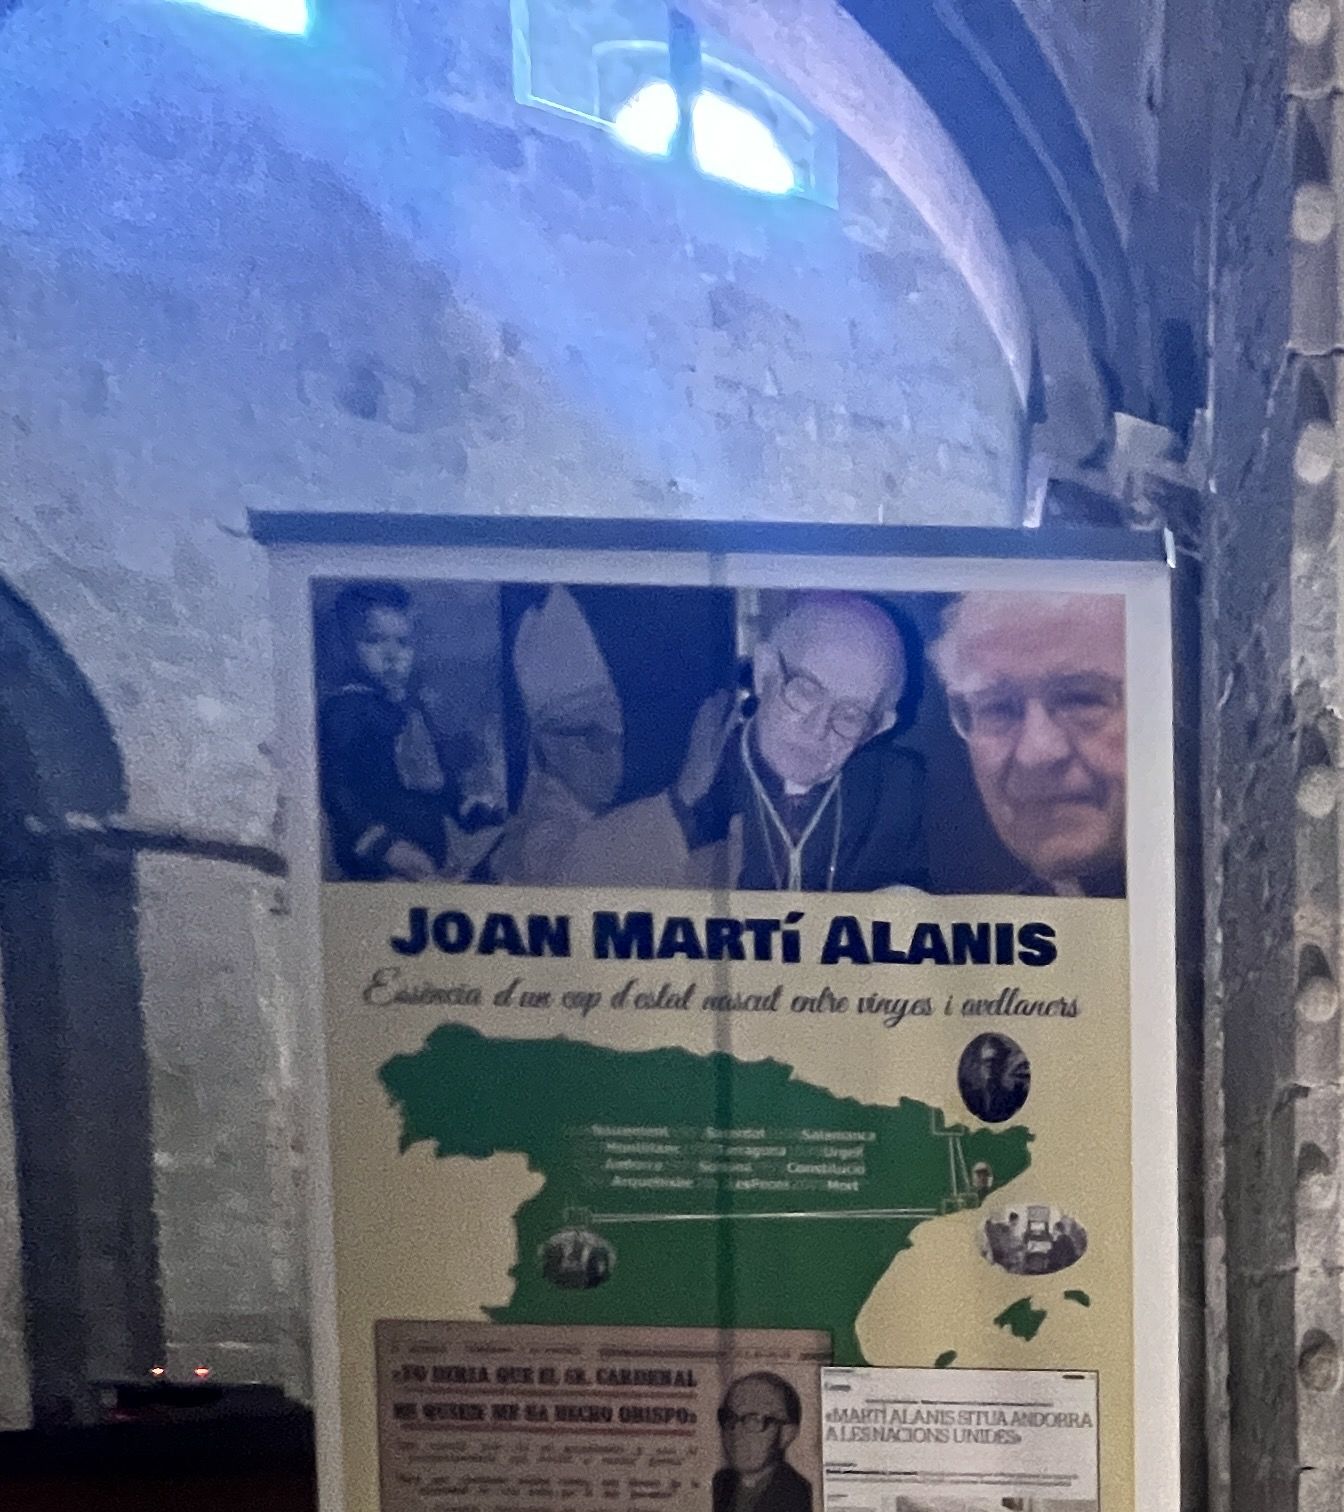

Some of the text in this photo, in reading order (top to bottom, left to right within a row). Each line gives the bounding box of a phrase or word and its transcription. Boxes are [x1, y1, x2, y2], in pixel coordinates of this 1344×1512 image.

[390, 906, 572, 958] JOAN
[820, 914, 1058, 966] ALANIS
[790, 985, 848, 1014] entre
[856, 992, 934, 1028] vinyes
[595, 1367, 698, 1388] CARDENAL
[891, 1409, 955, 1427] ALANIS
[1010, 1411, 1094, 1429] ANDORRA
[825, 1425, 838, 1442] A
[872, 1425, 950, 1444] NACIONS
